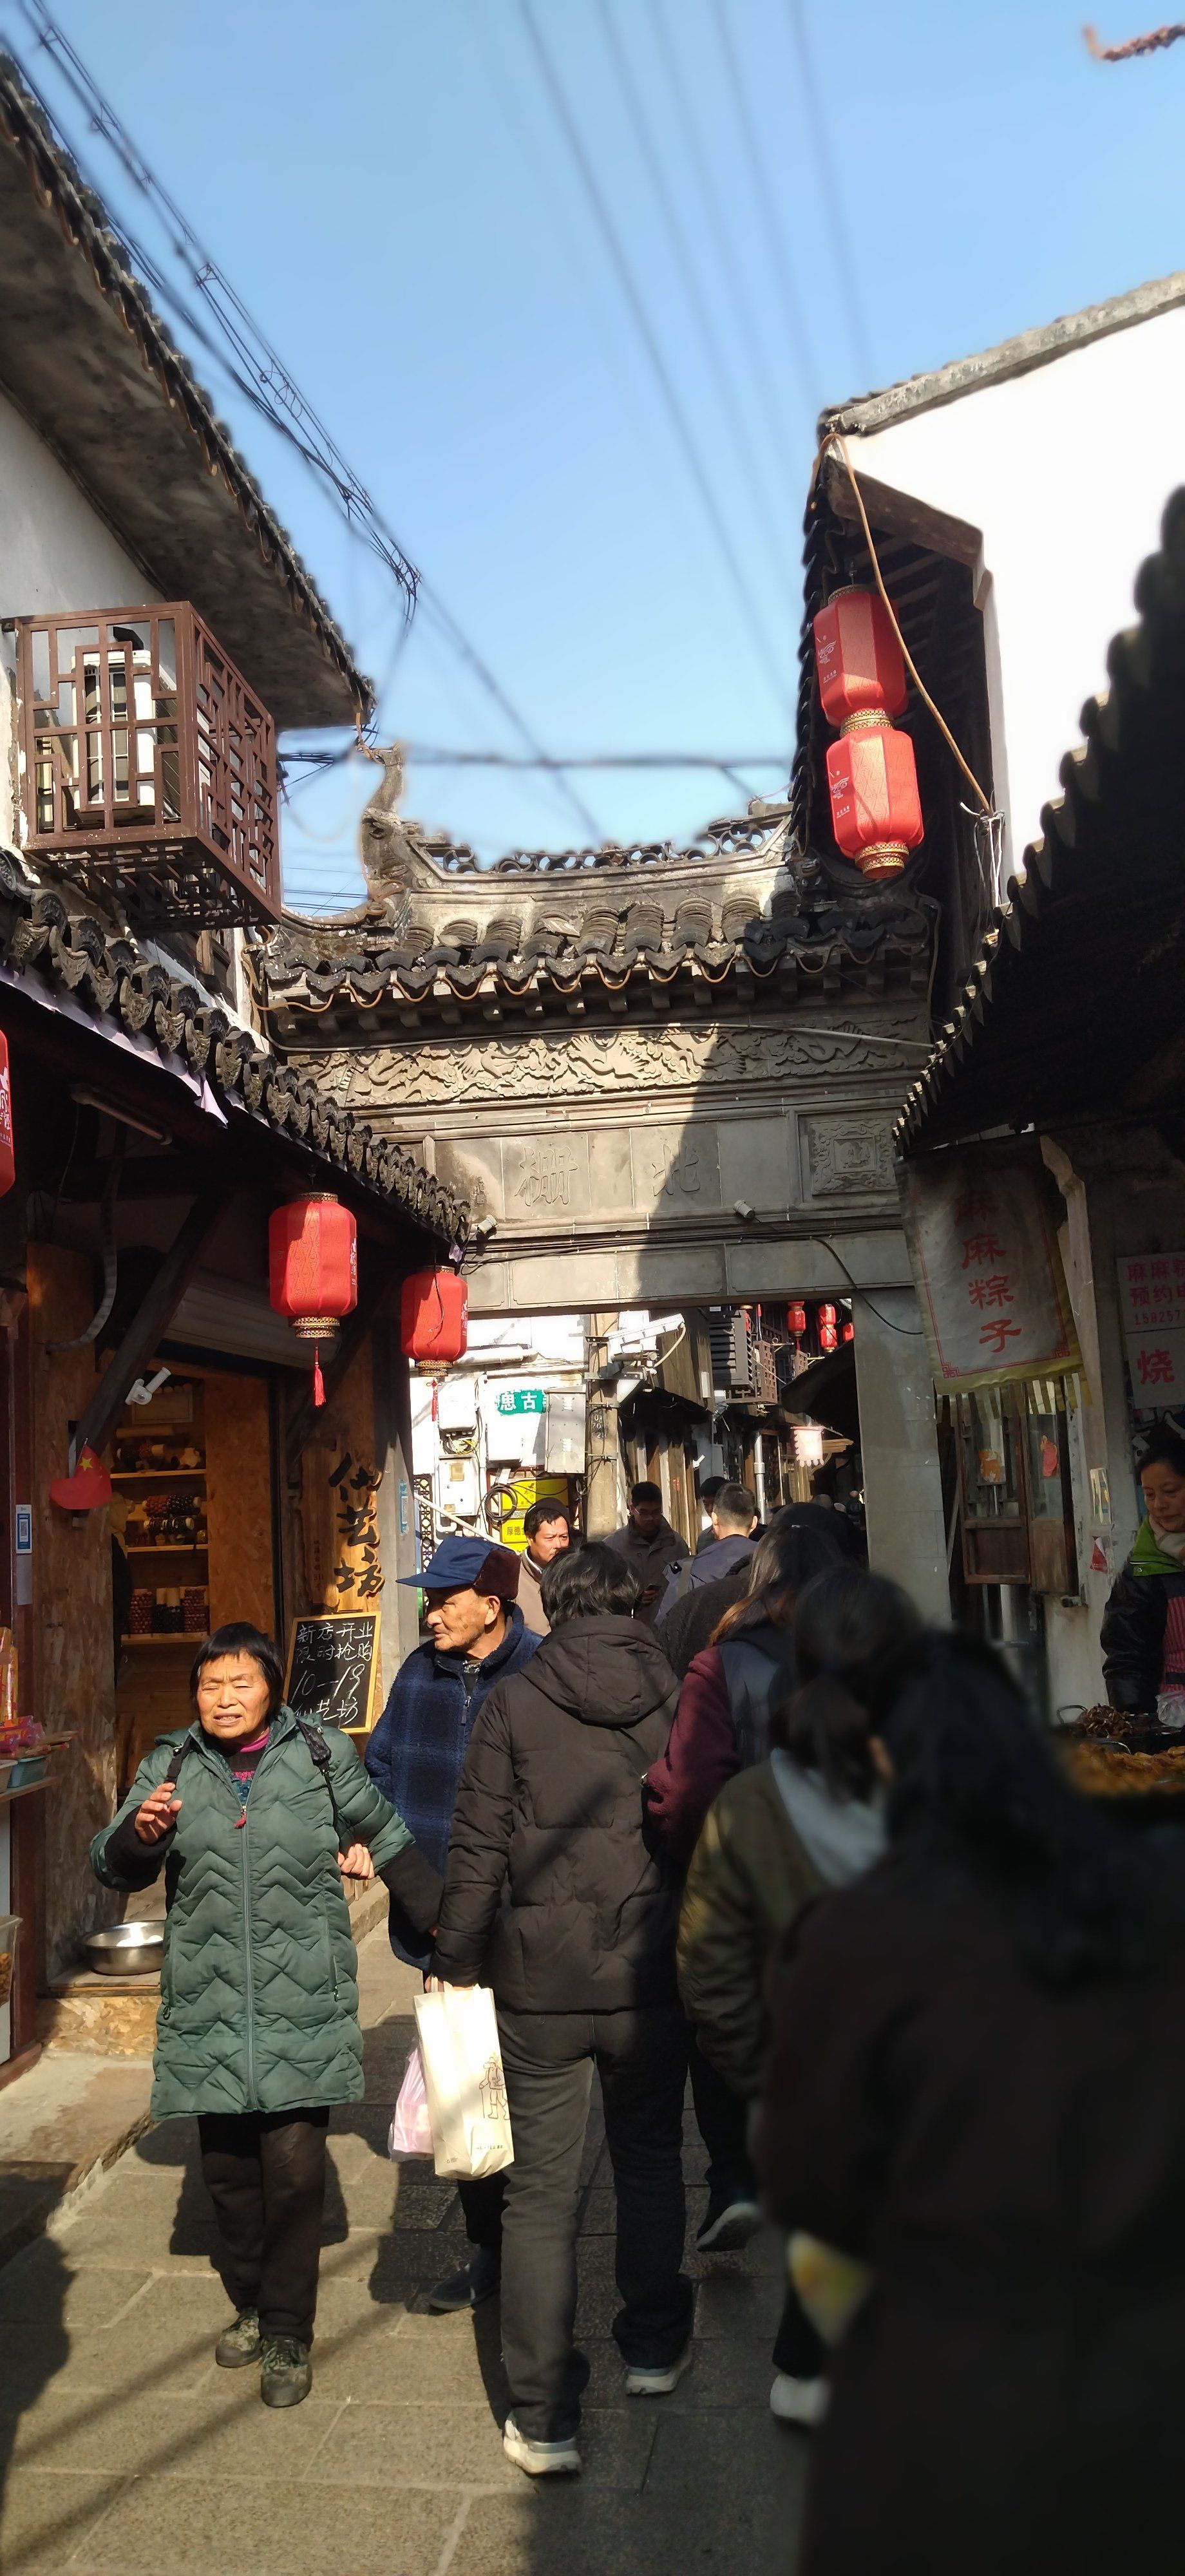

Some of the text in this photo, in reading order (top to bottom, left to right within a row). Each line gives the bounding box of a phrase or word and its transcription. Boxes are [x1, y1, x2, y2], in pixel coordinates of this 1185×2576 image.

[1137, 1349, 1175, 1385] 烧
[297, 1621, 373, 1643] 新店开业
[296, 1641, 372, 1663] 限时抢购
